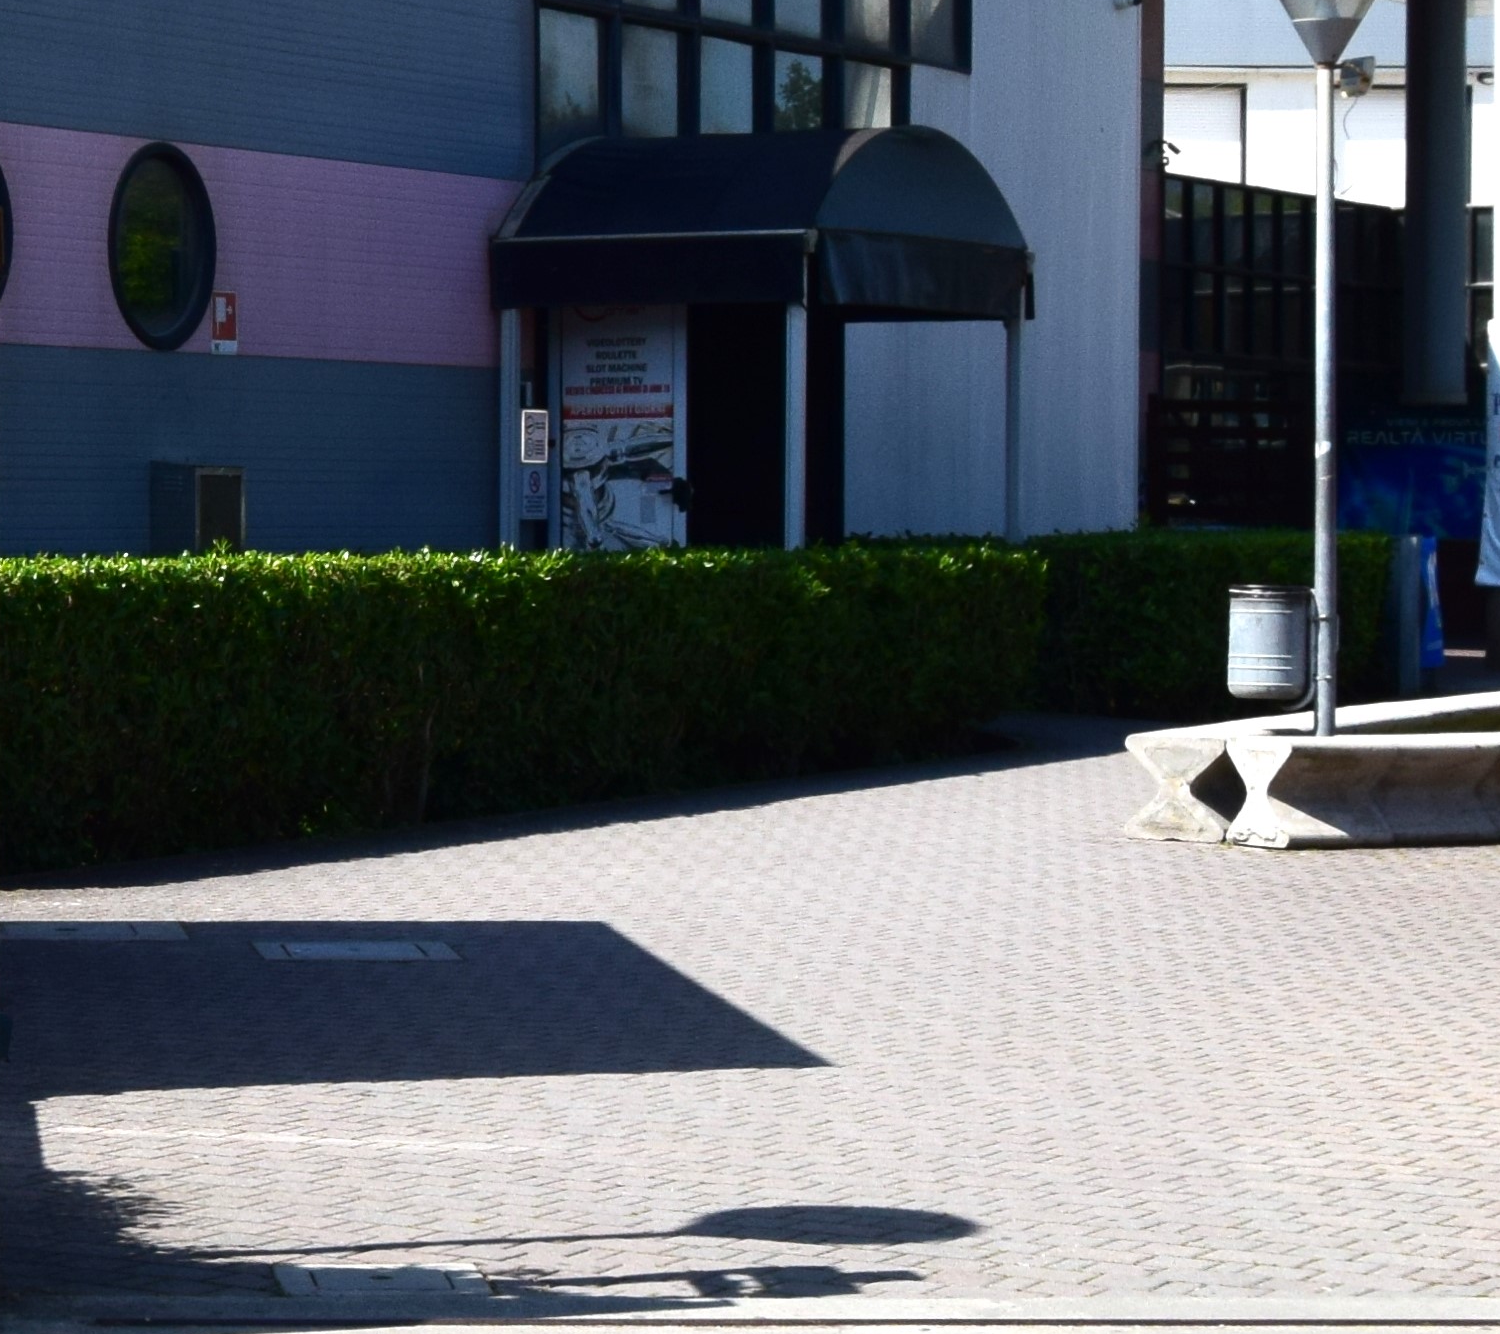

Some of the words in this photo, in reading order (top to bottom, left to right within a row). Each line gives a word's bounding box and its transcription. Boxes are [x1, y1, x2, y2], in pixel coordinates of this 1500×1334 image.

[586, 337, 647, 347] VIDEOLOTTERY
[596, 350, 637, 360] ROULETTE
[585, 363, 606, 373] SLOT
[608, 362, 648, 372] MACHINE
[590, 376, 631, 386] PREMIUM
[632, 376, 644, 385] TV
